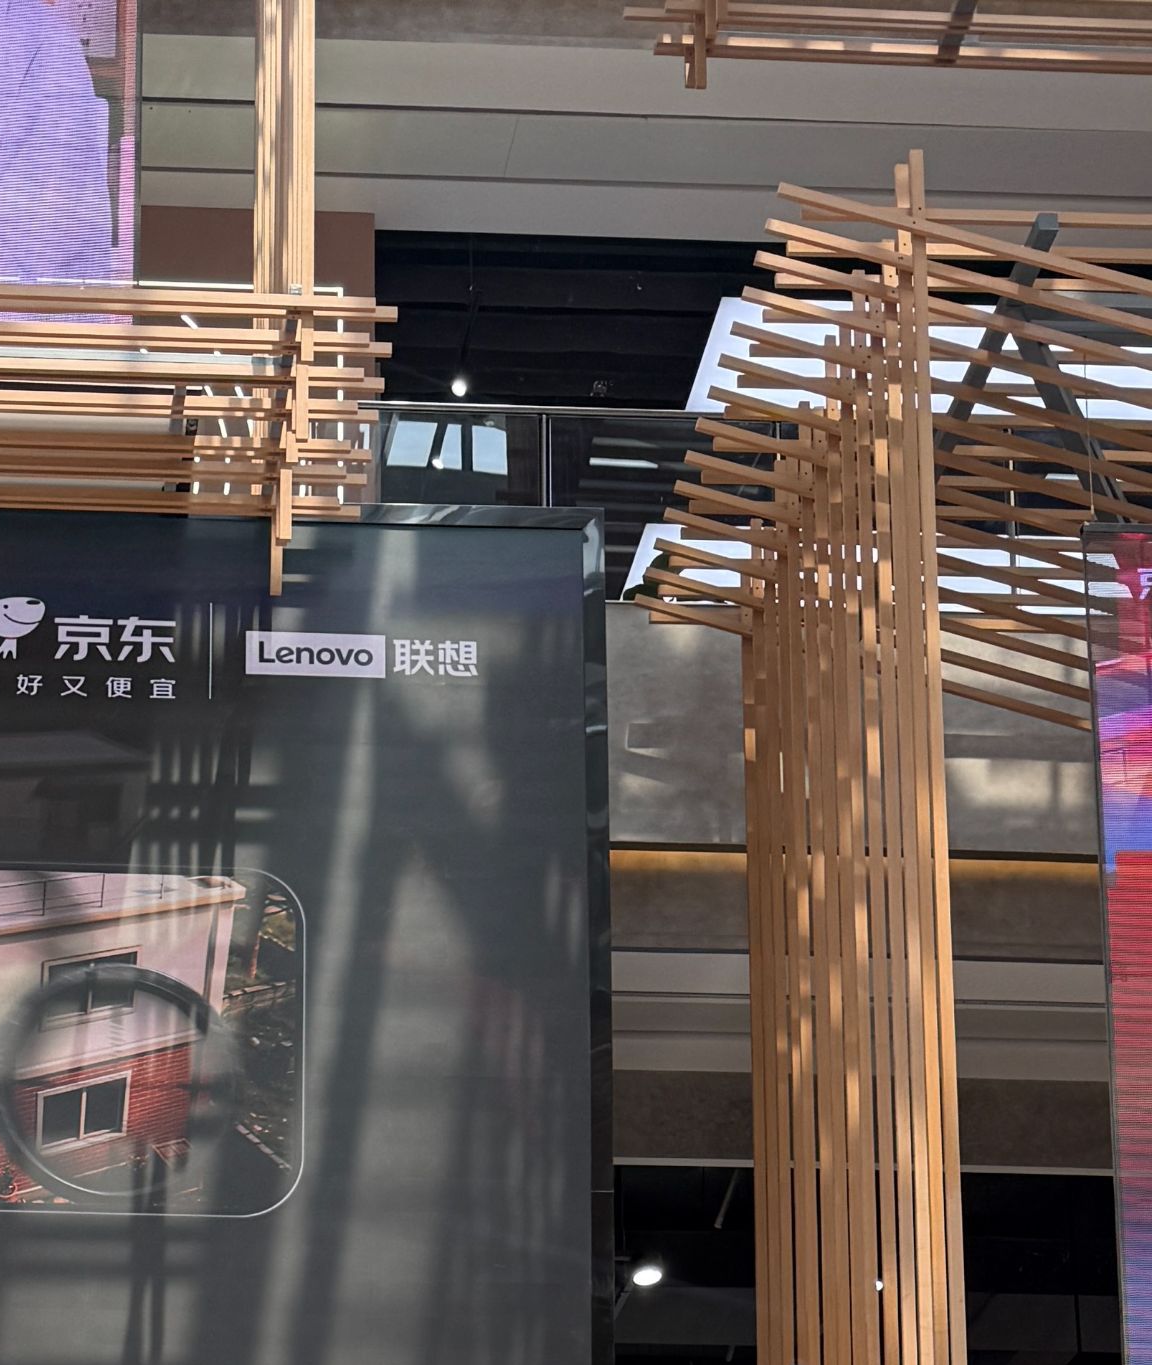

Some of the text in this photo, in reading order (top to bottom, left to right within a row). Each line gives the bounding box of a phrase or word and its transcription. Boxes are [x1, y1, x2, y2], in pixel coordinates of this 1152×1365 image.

[53, 615, 177, 663] 京东
[257, 640, 374, 667] Lenovo
[392, 638, 478, 677] 联想
